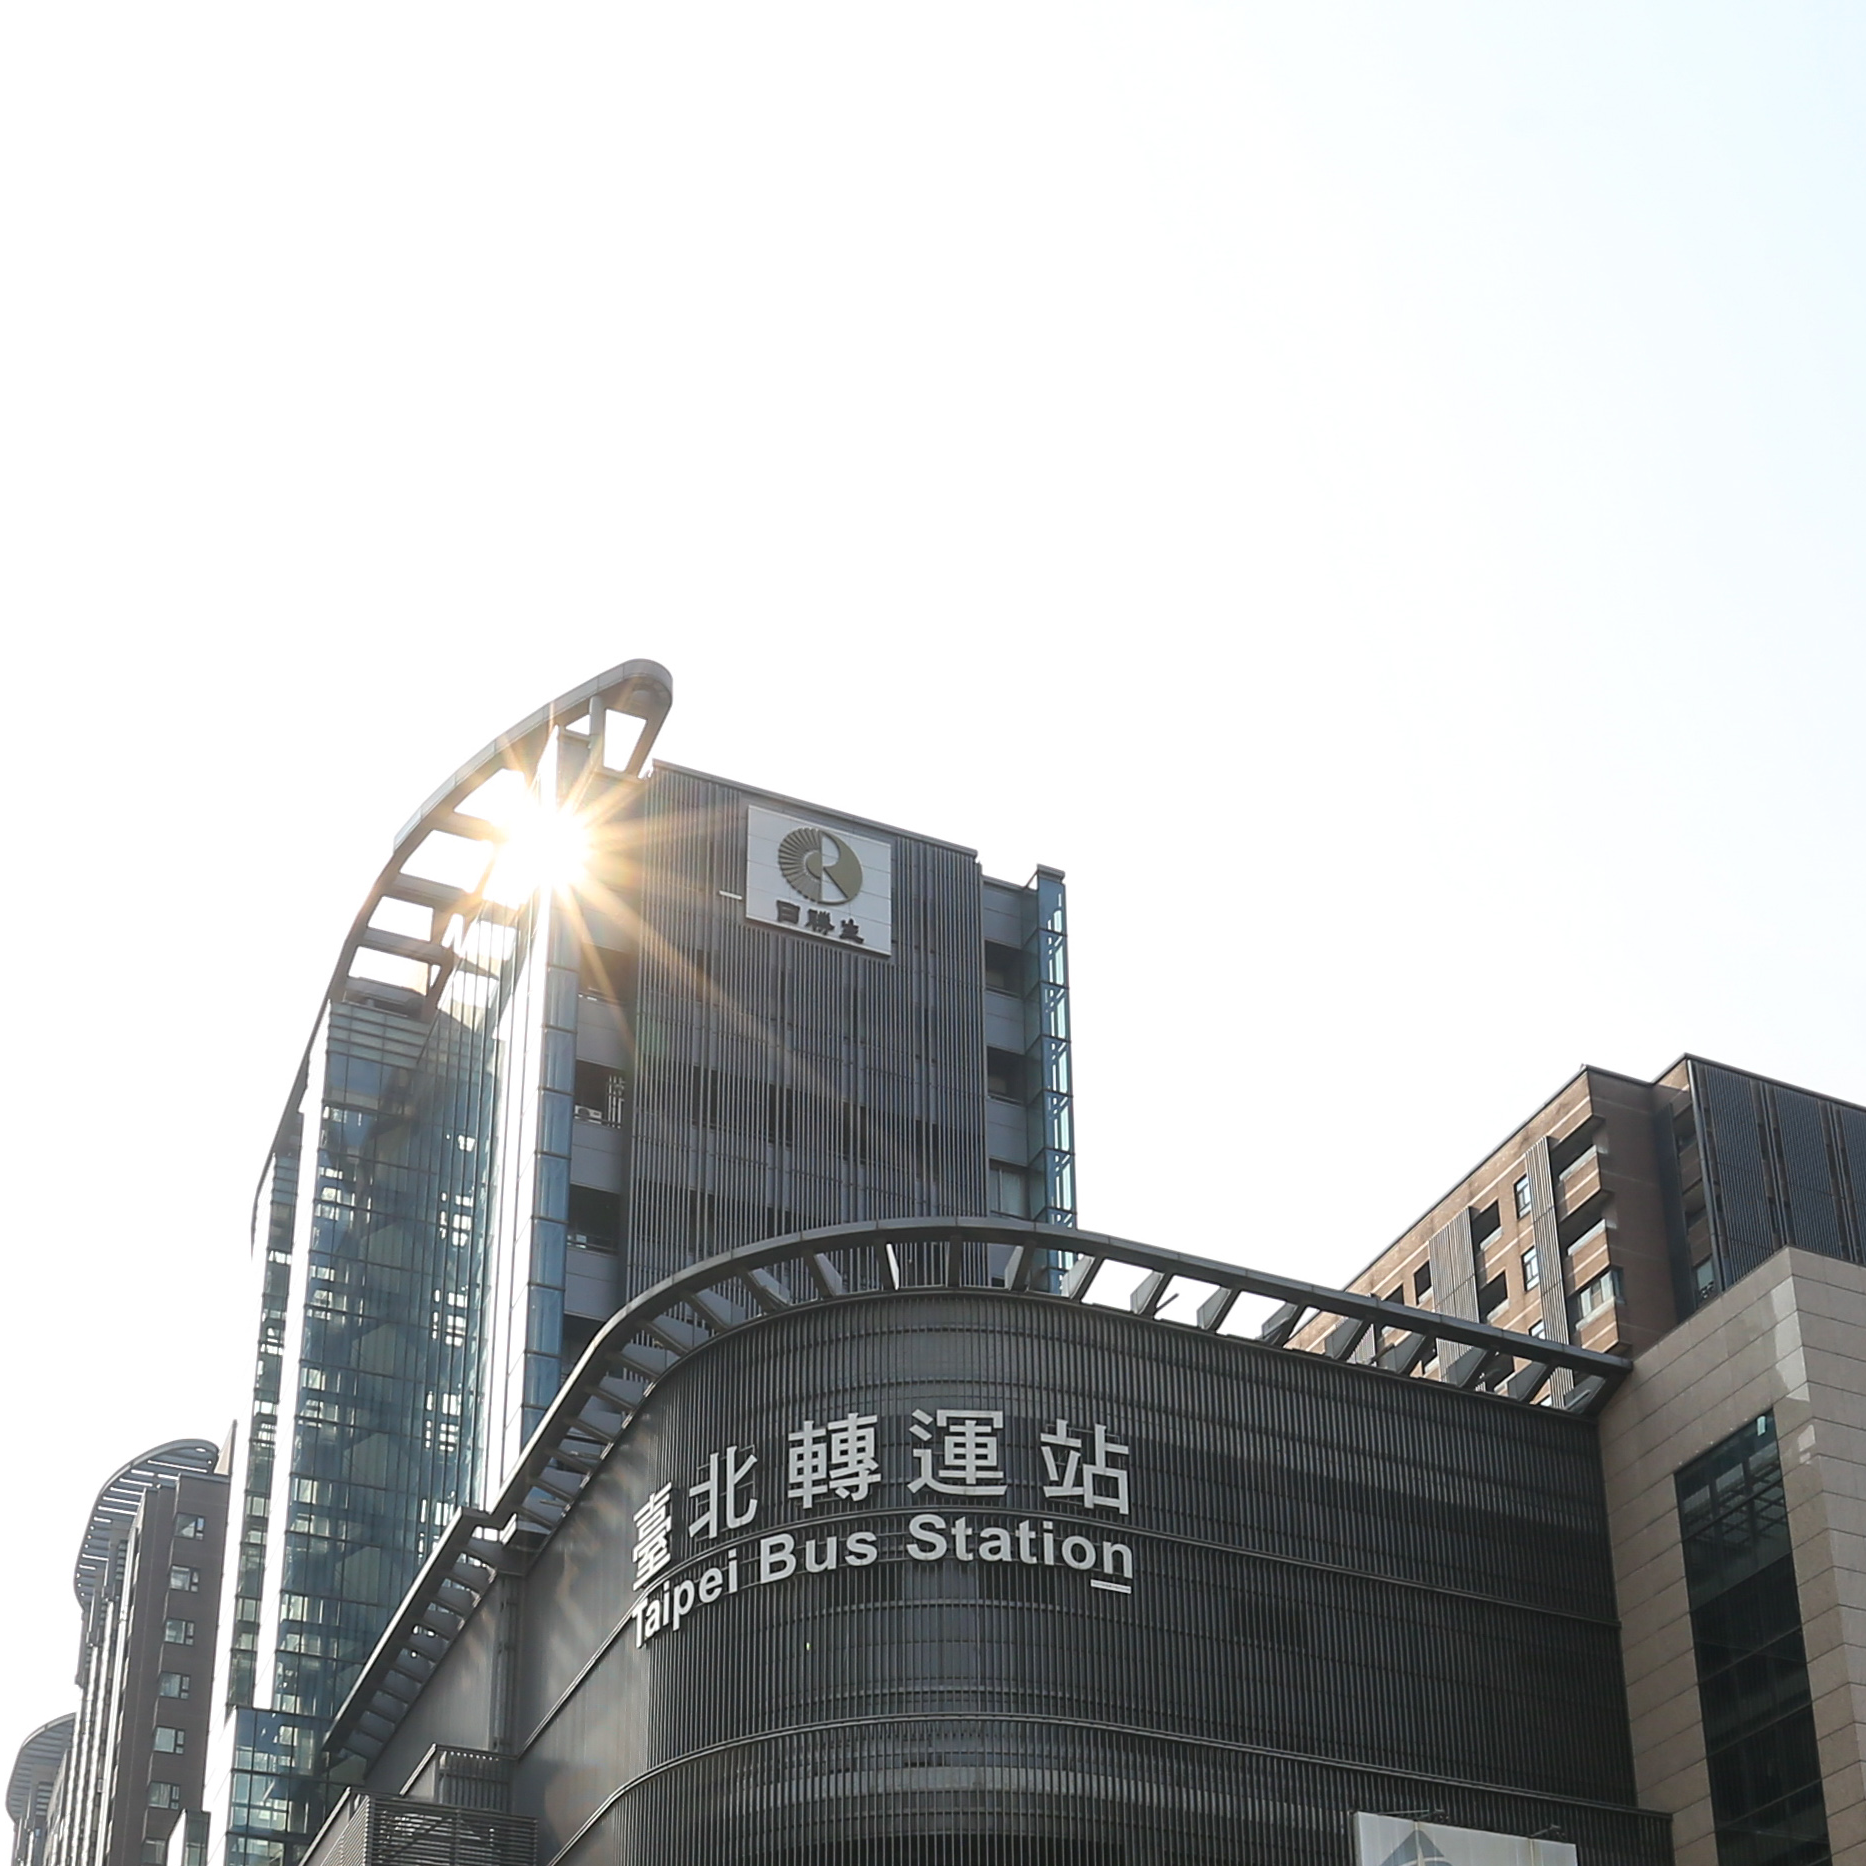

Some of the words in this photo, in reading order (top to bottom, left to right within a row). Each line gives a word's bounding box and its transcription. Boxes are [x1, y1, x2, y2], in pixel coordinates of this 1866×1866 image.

[632, 1408, 1130, 1592] 臺北轉運站
[632, 1551, 738, 1648] Taipei
[758, 1527, 879, 1584] Bus
[905, 1513, 1133, 1579] Station
